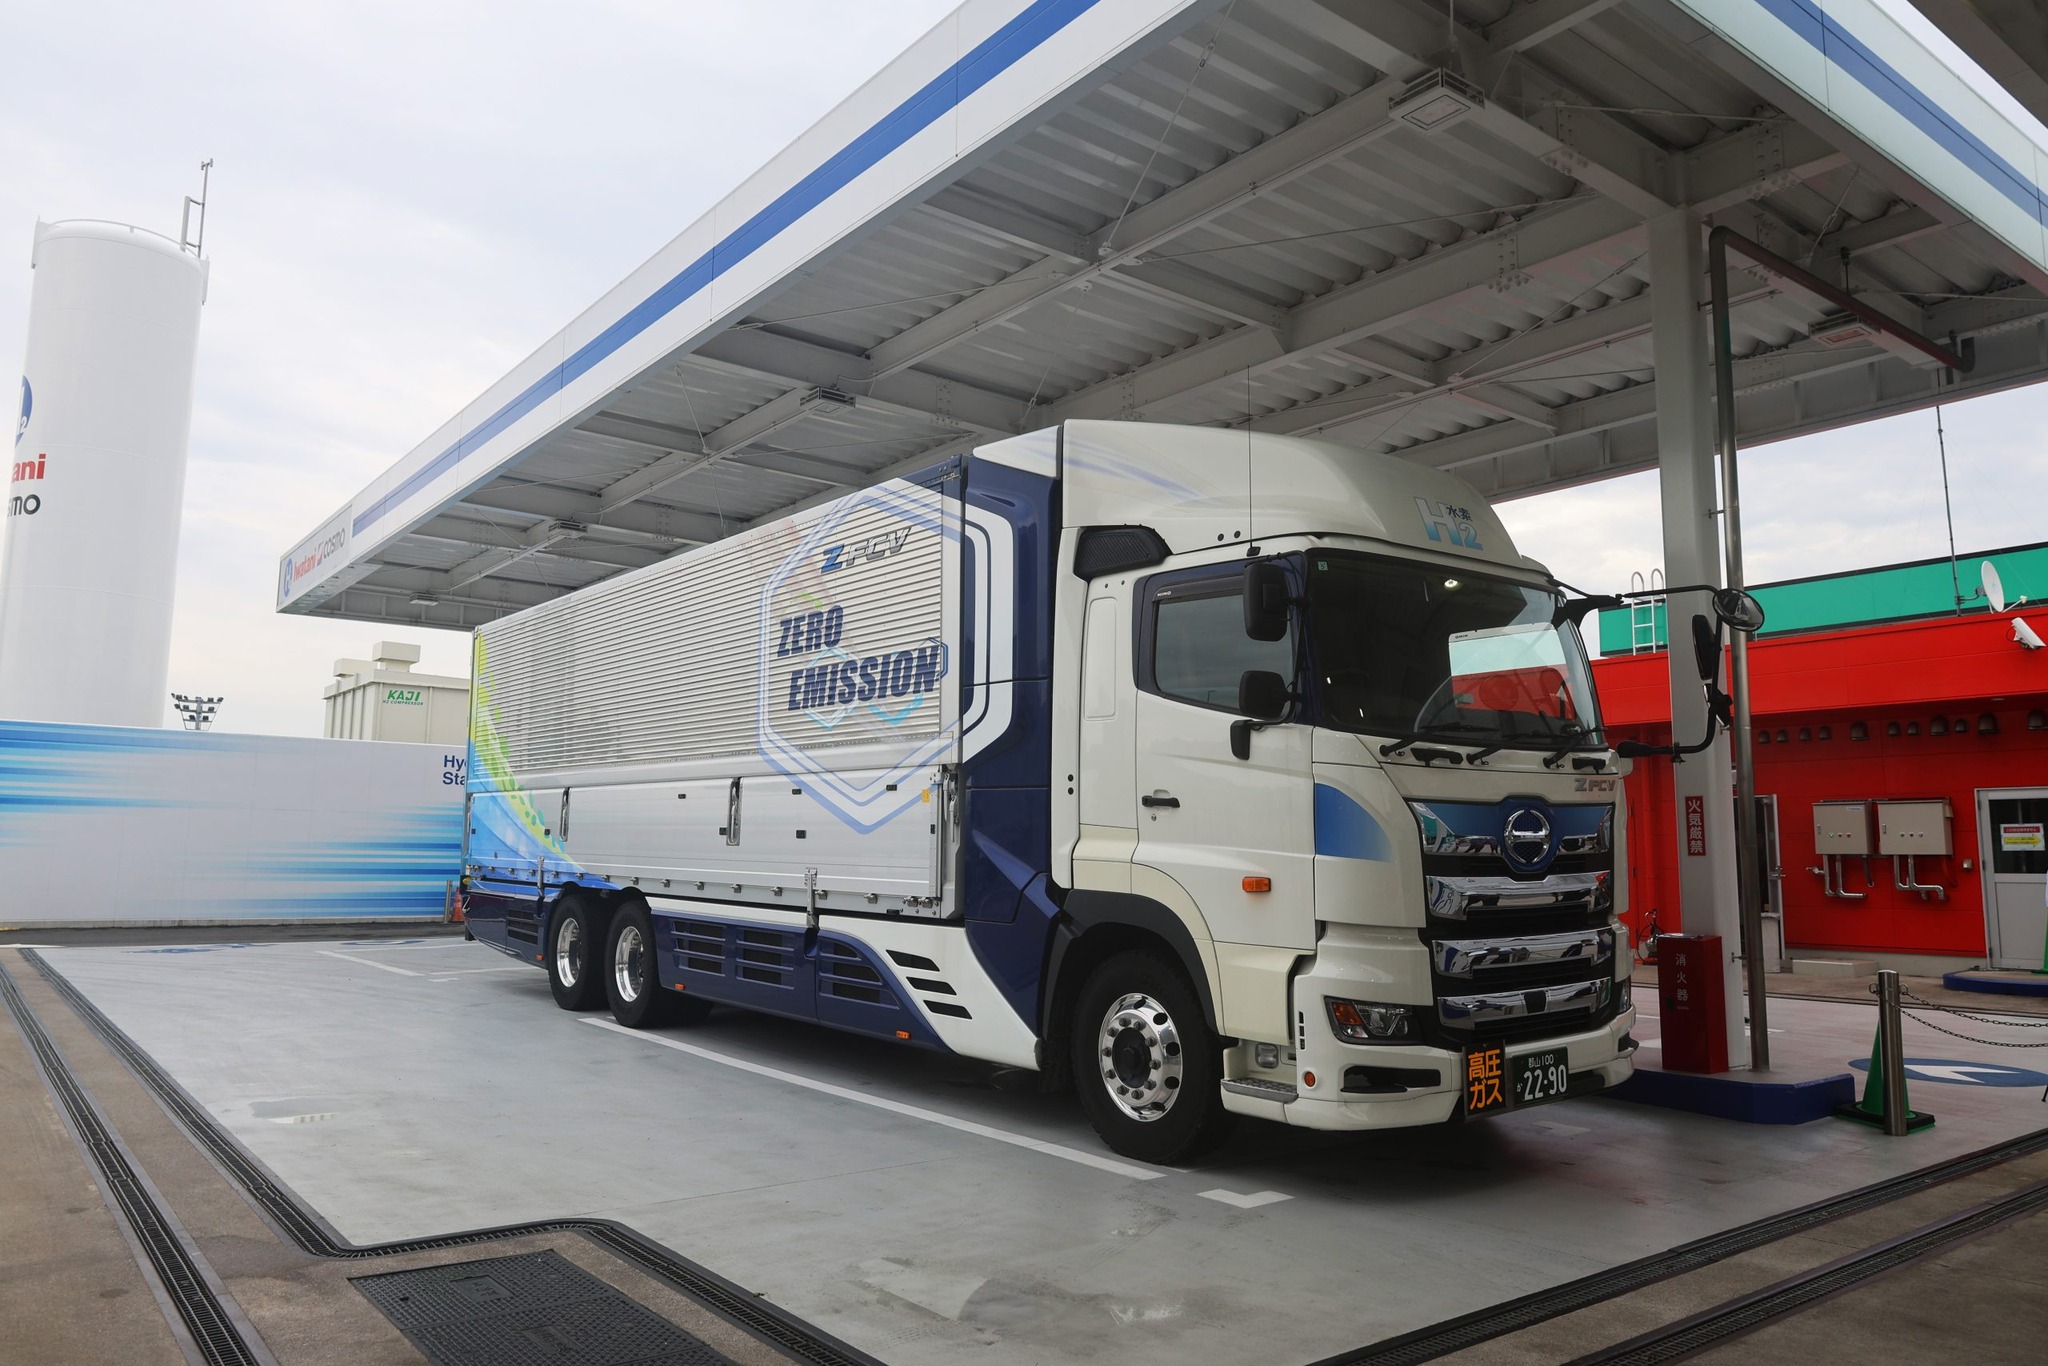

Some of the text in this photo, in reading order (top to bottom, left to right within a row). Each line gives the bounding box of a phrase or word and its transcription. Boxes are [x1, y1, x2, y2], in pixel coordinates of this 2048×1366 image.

[12, 453, 46, 483] ani
[1414, 496, 1483, 551] H2
[1446, 504, 1473, 522] 水素
[777, 604, 844, 657] ZERO
[387, 690, 421, 701] KAJI
[788, 645, 939, 710] EMISSION
[1687, 798, 1704, 854] 火気厳禁
[1675, 953, 1689, 1001] 消火器
[1468, 1049, 1501, 1081] 高圧
[1469, 1079, 1503, 1110] ガス
